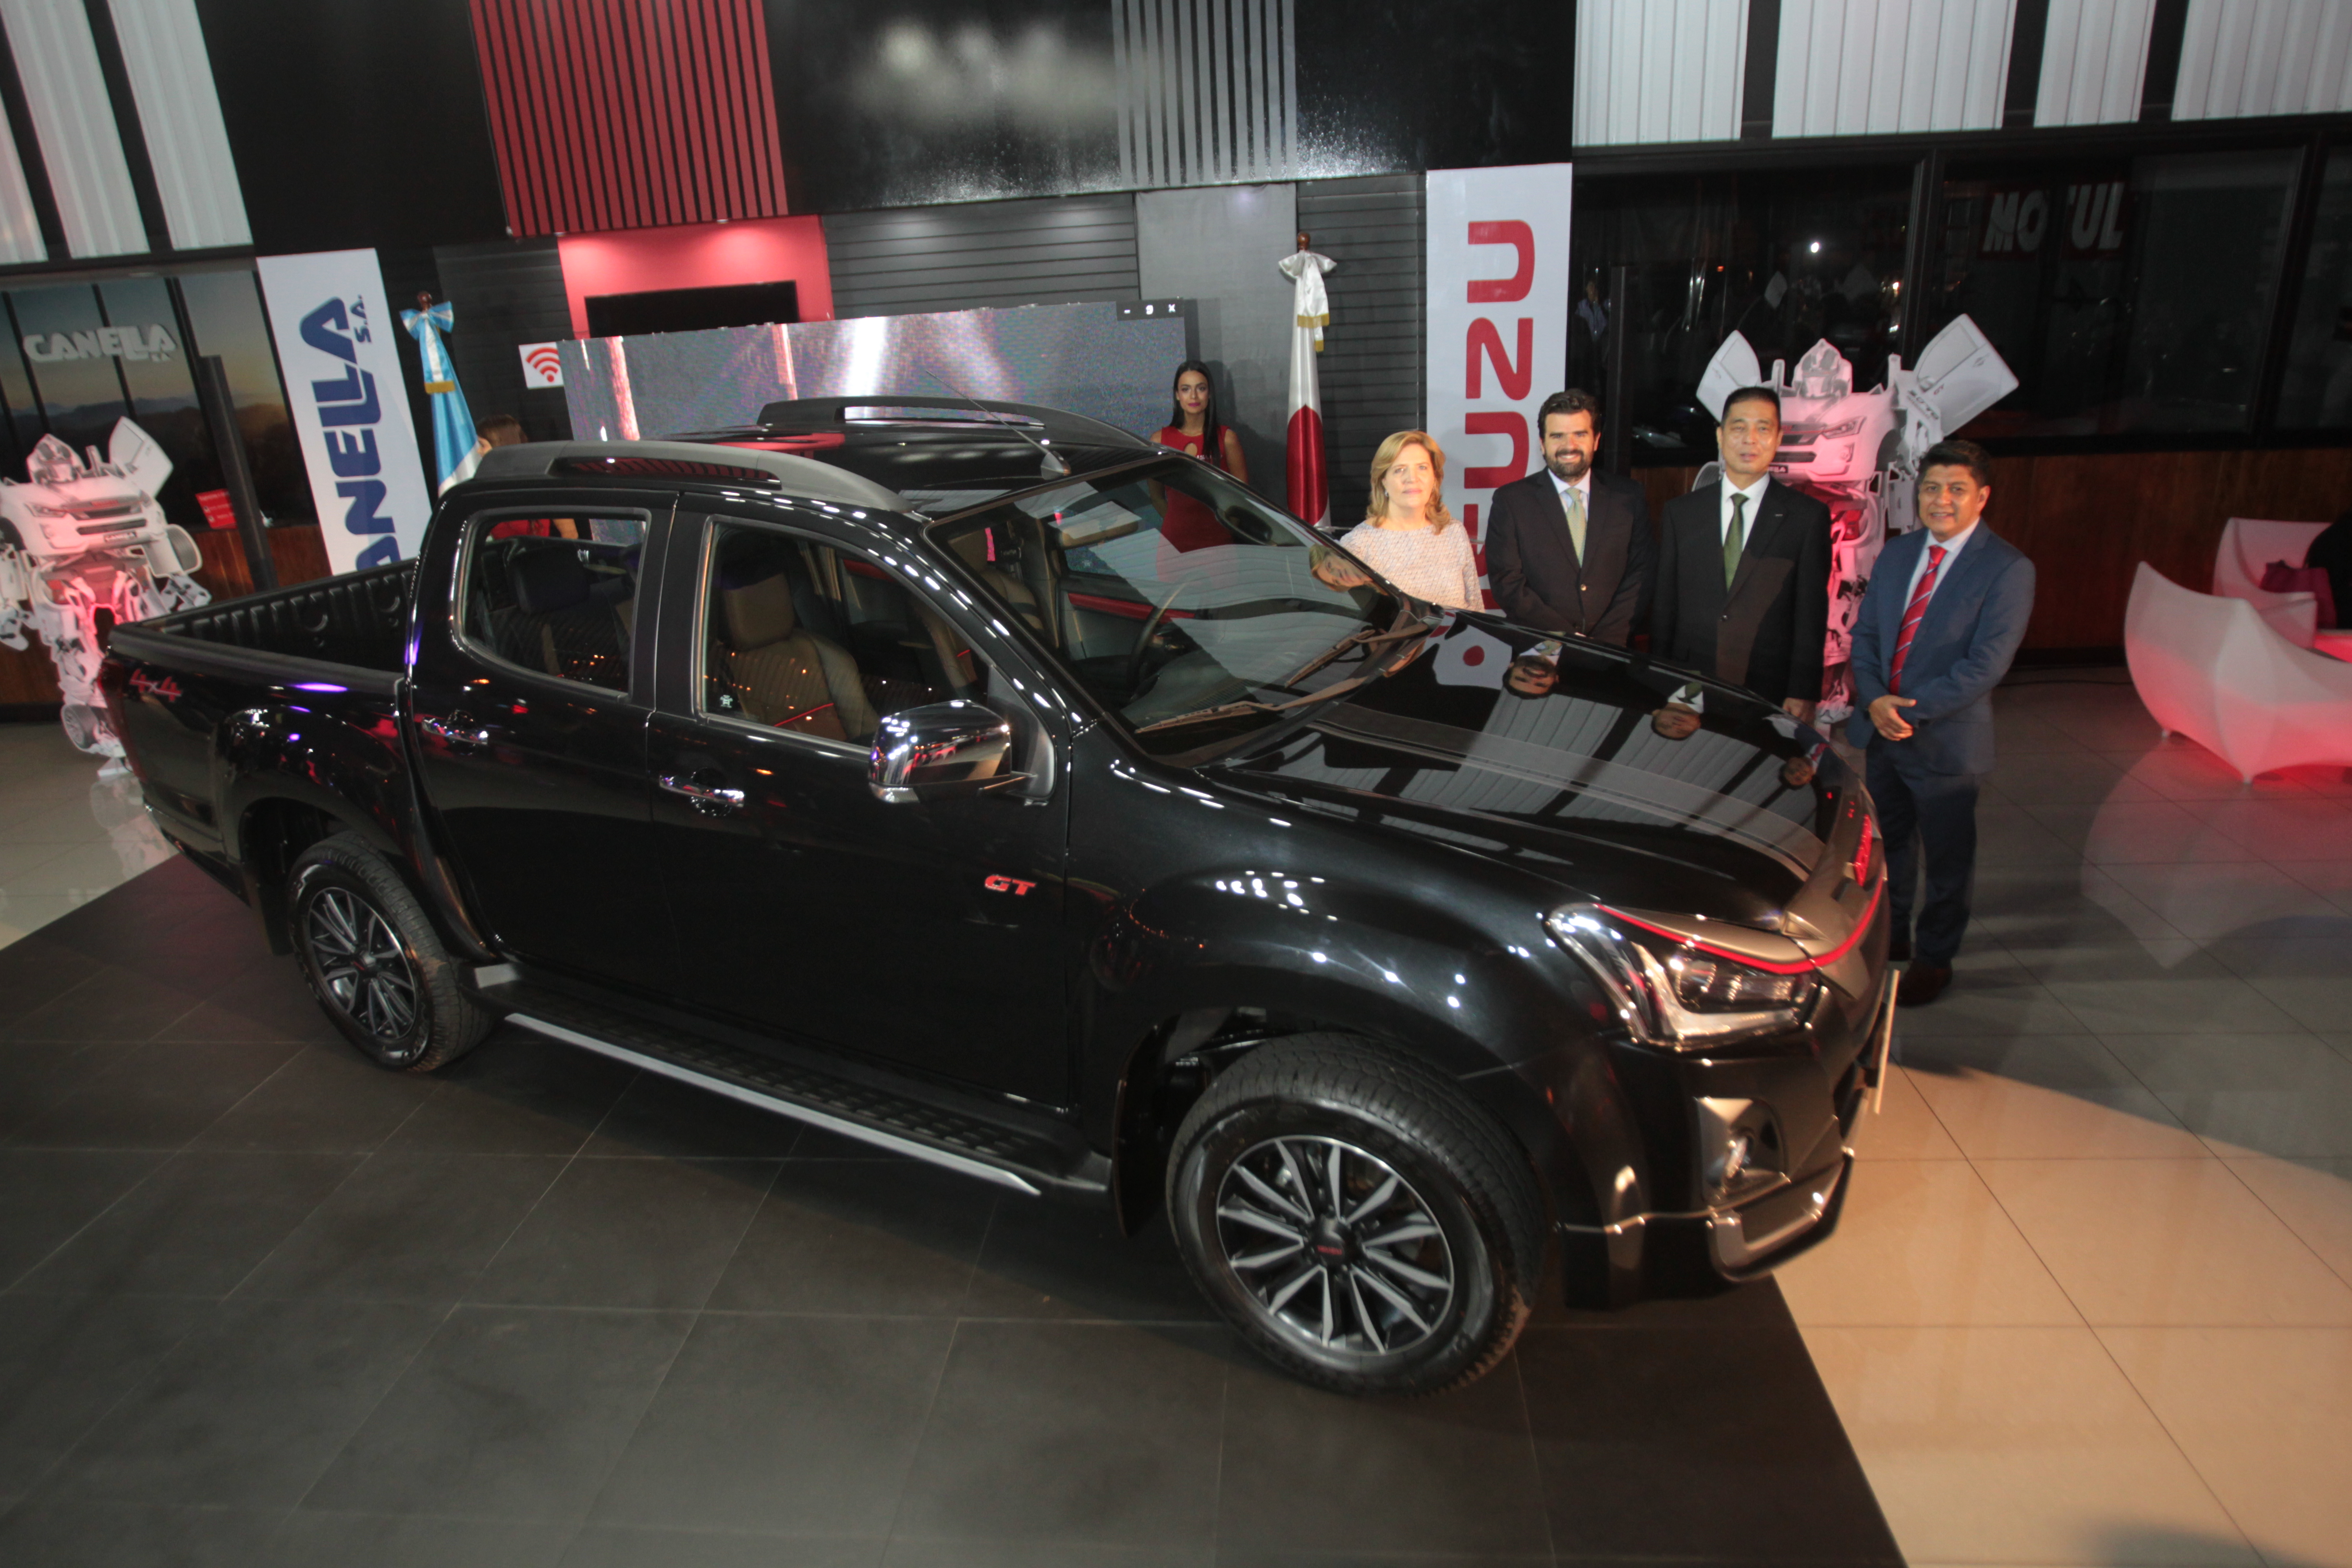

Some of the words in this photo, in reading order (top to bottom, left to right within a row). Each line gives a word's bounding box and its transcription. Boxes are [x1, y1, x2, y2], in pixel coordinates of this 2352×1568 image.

[1983, 181, 2125, 252] MOUL
[23, 324, 177, 361] CANELLA
[984, 874, 1037, 896] GT
